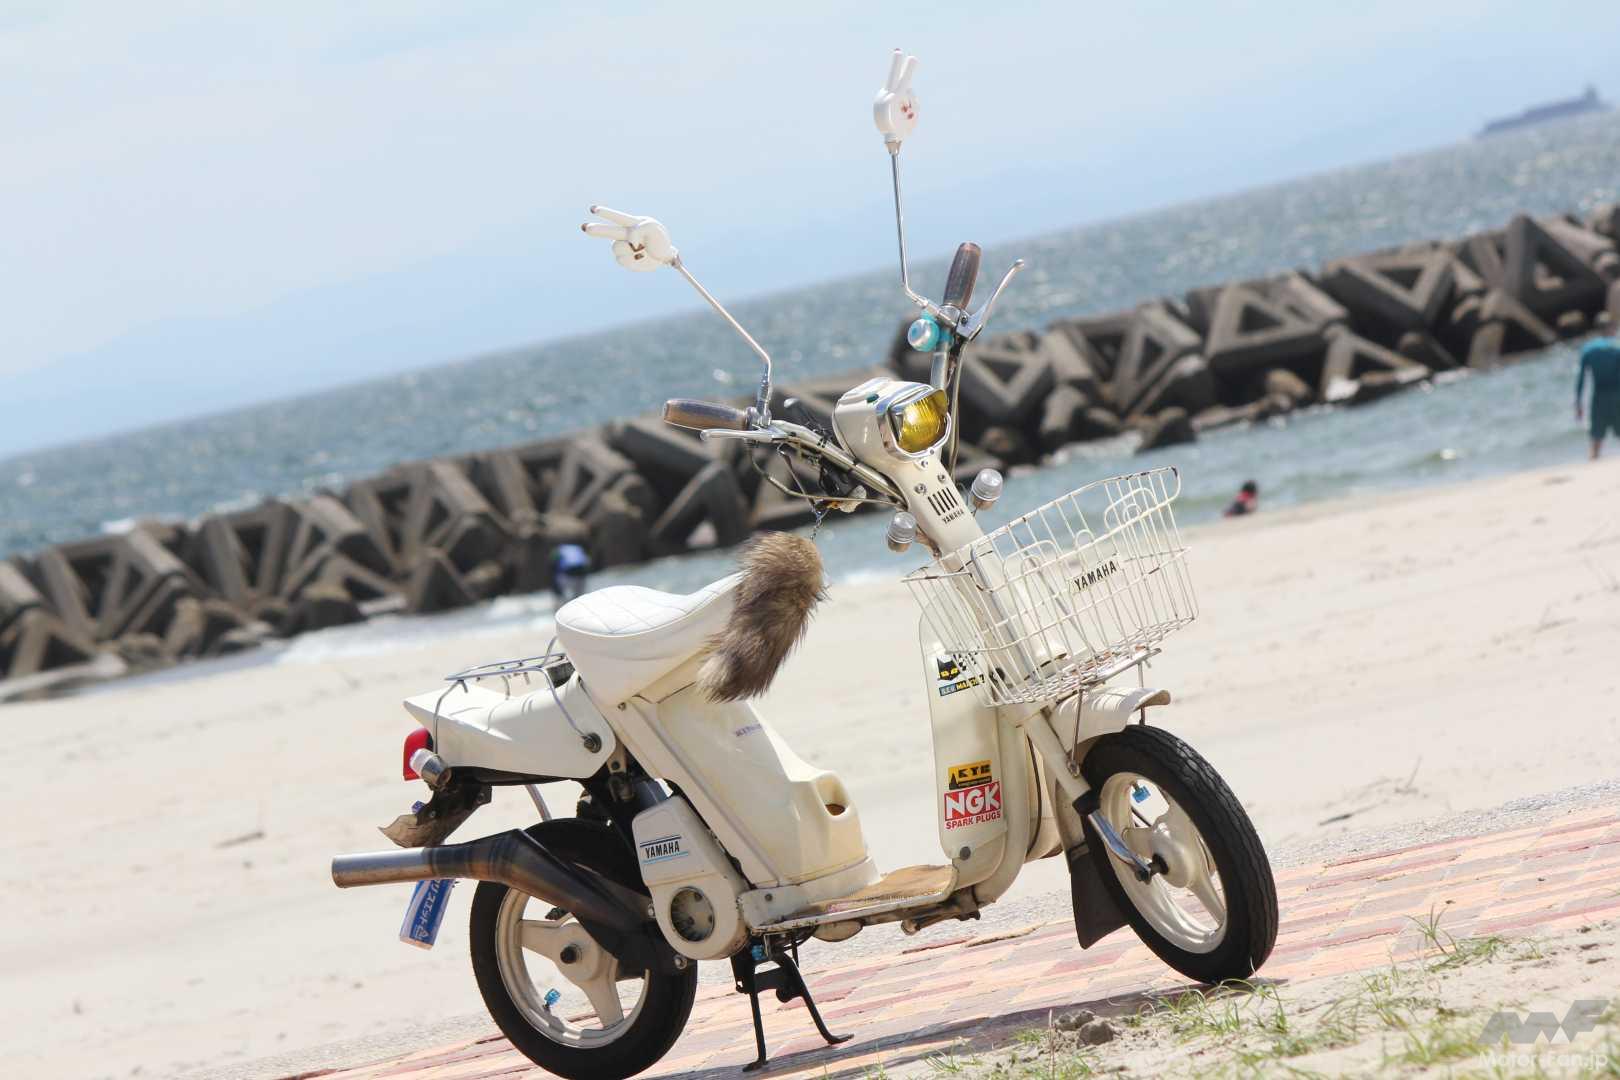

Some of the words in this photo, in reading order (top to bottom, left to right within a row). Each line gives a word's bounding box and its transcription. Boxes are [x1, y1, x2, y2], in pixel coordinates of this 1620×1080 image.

[942, 509, 965, 524] YAMAHA
[1074, 560, 1117, 591] YAMAHA
[945, 783, 1000, 819] NGK
[945, 818, 974, 830] SPARK
[975, 811, 1001, 824] PLUGS
[645, 840, 680, 859] YAMAHA
